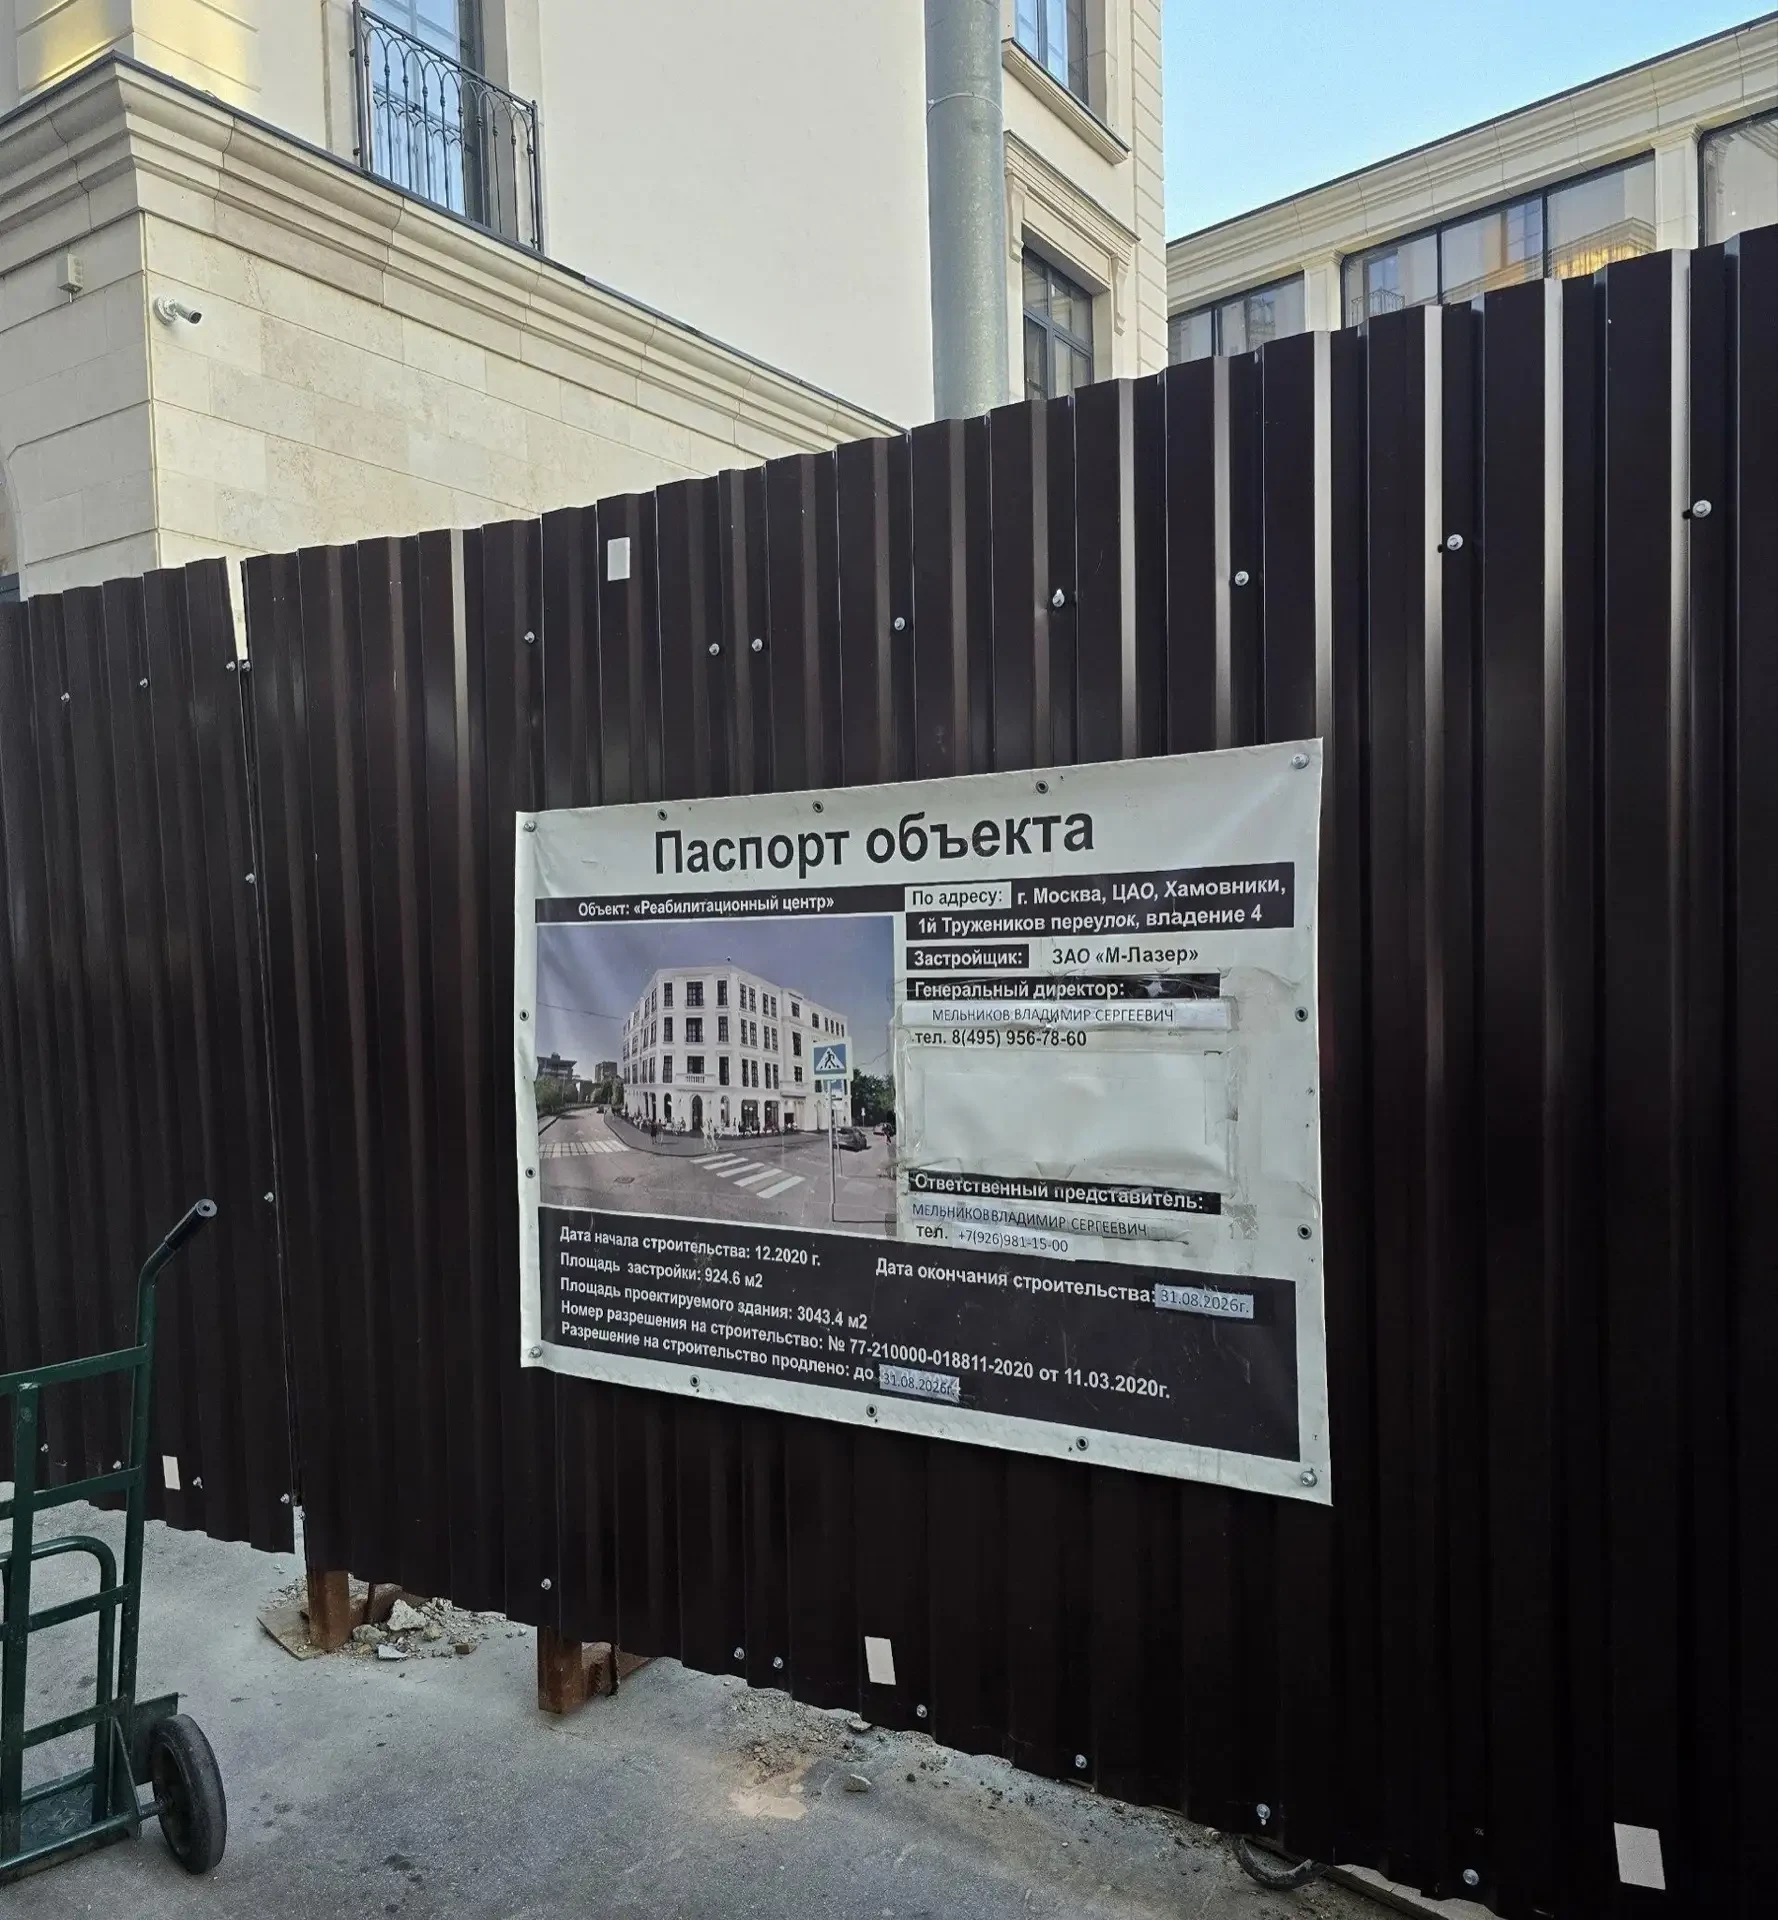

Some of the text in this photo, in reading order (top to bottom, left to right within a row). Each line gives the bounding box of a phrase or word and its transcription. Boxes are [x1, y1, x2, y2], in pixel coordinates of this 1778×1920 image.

[655, 811, 1095, 879] Паспорт объекта
[578, 895, 834, 917] Объект: «Реабилитационный центр»
[912, 876, 1286, 908] По адресу: г. Москва, ЦАО, Хамовники,
[918, 904, 1262, 935] 1й Тружеников переулок, владение 4
[914, 947, 1199, 968] Застройщик: ЗАО «М-Лазер»
[915, 980, 1124, 999] Генеральный директор:
[932, 1007, 1174, 1023] МЕЛЬНИКОВ ВЛАДИМИР СЕРГЕЕВИЧ
[915, 1030, 1087, 1047] тел. 8(495) 956-78-60
[915, 1173, 1203, 1210] Ответственный представитель:
[916, 1225, 1068, 1253] тел. +7(926)981-15-00
[1071, 1218, 1147, 1237] СЕРГЕЕВИЧ
[560, 1226, 821, 1266] Дата начала строительства: 12.2020 г.
[561, 1252, 763, 1288] Площадь застройки: 924.6 м2
[876, 1258, 1250, 1314] Дата окончания строительства: 31.08.2026г.
[561, 1277, 868, 1330] Площадь проектируемого здания: 3043.4 м2
[561, 1300, 1170, 1400] Номер разрешения на строительство: № 77-210000-018811-2020 от 11.03.2020г.
[561, 1321, 640, 1346] Разрешение
[643, 1334, 659, 1348] на
[663, 1338, 767, 1365] строительство
[771, 1355, 850, 1378] продлено:
[853, 1366, 874, 1382] до
